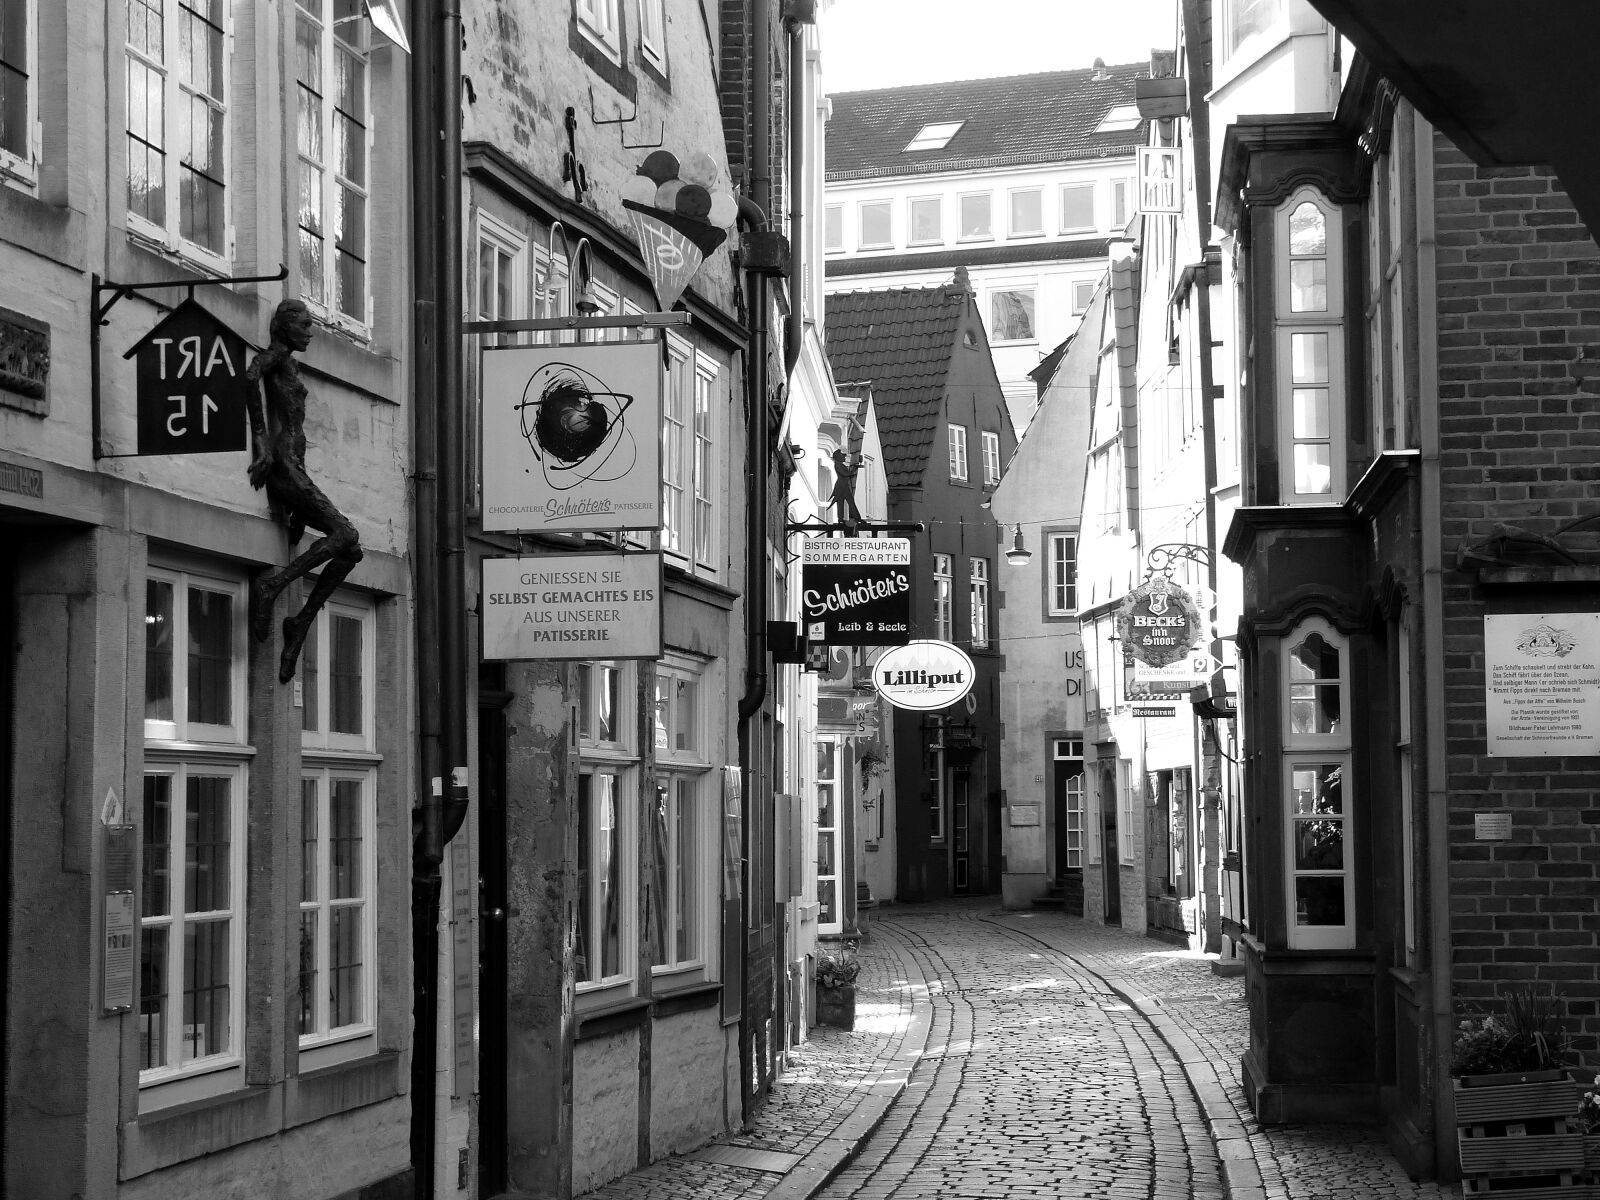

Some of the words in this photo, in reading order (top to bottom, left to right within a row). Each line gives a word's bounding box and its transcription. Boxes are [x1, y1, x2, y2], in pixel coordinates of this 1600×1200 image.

[488, 505, 544, 514] CHOCOLATERIE
[614, 502, 653, 510] PATISSERIE
[804, 553, 908, 562] SOMMERGARTEN
[520, 572, 597, 585] GENIESSEN
[601, 571, 622, 583] SIE
[489, 592, 538, 605] SELBST
[542, 590, 629, 604] GEMACHTES
[633, 589, 654, 602] EIS
[803, 570, 910, 617] Schröter's
[523, 611, 553, 623] AUS
[557, 609, 621, 623] UNSERER
[838, 622, 861, 632] Leib
[866, 622, 874, 632] &
[878, 622, 907, 632] Seele
[533, 629, 610, 642] PATISSERIE
[1142, 634, 1176, 646] Snoor
[883, 669, 966, 689] Lilliput
